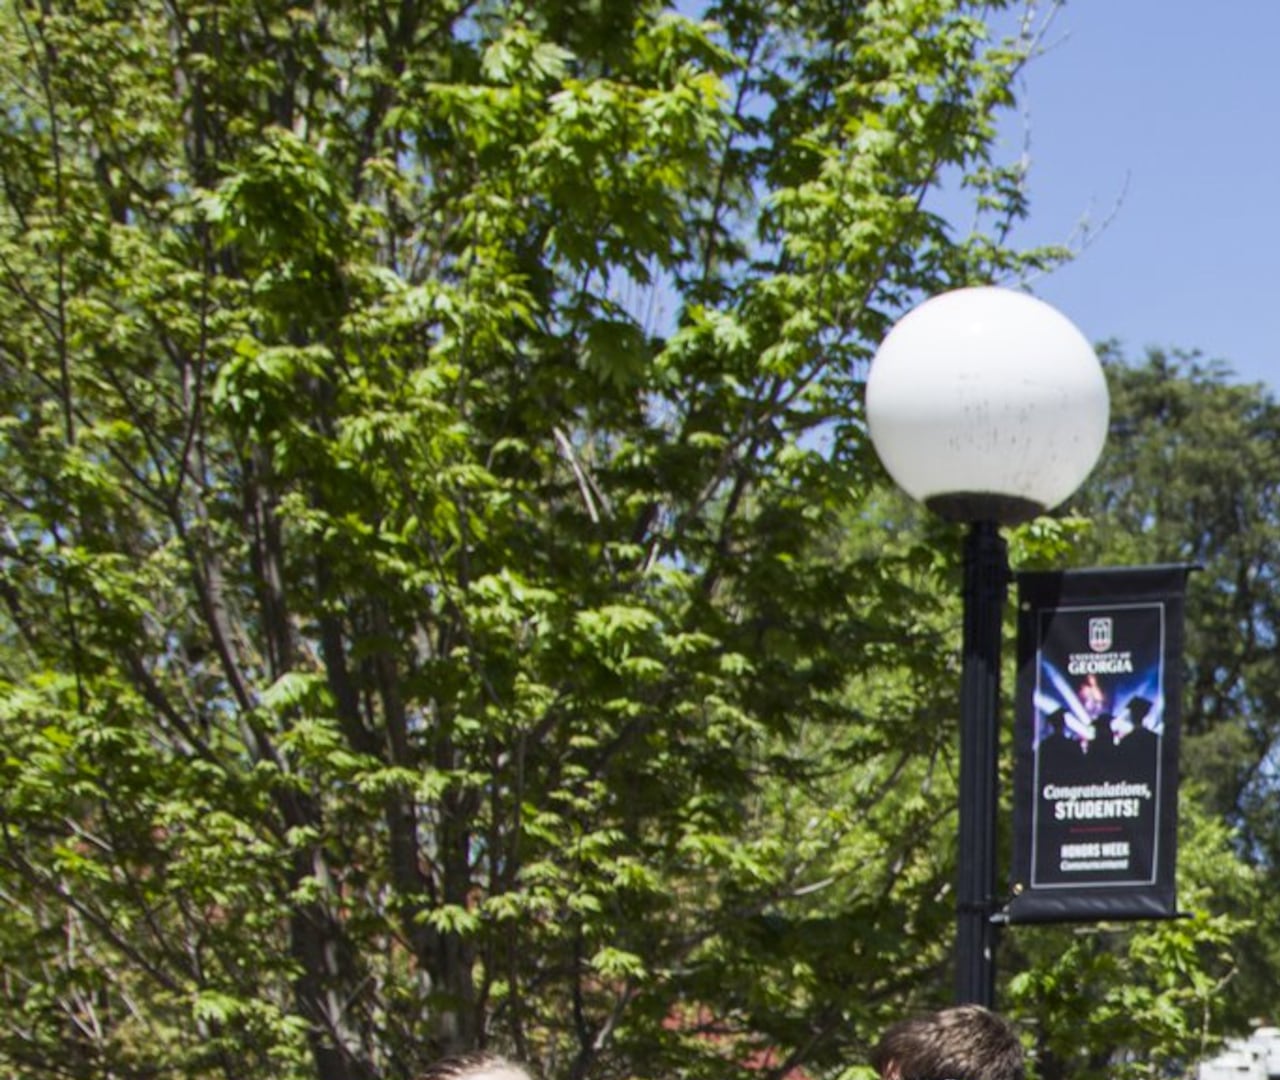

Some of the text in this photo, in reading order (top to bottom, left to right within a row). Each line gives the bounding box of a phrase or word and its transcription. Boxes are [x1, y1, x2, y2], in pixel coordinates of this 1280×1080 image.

[1068, 660, 1133, 675] GEORGIA
[1043, 781, 1152, 803] Congratulations,
[1055, 799, 1139, 819] STUDENTS!
